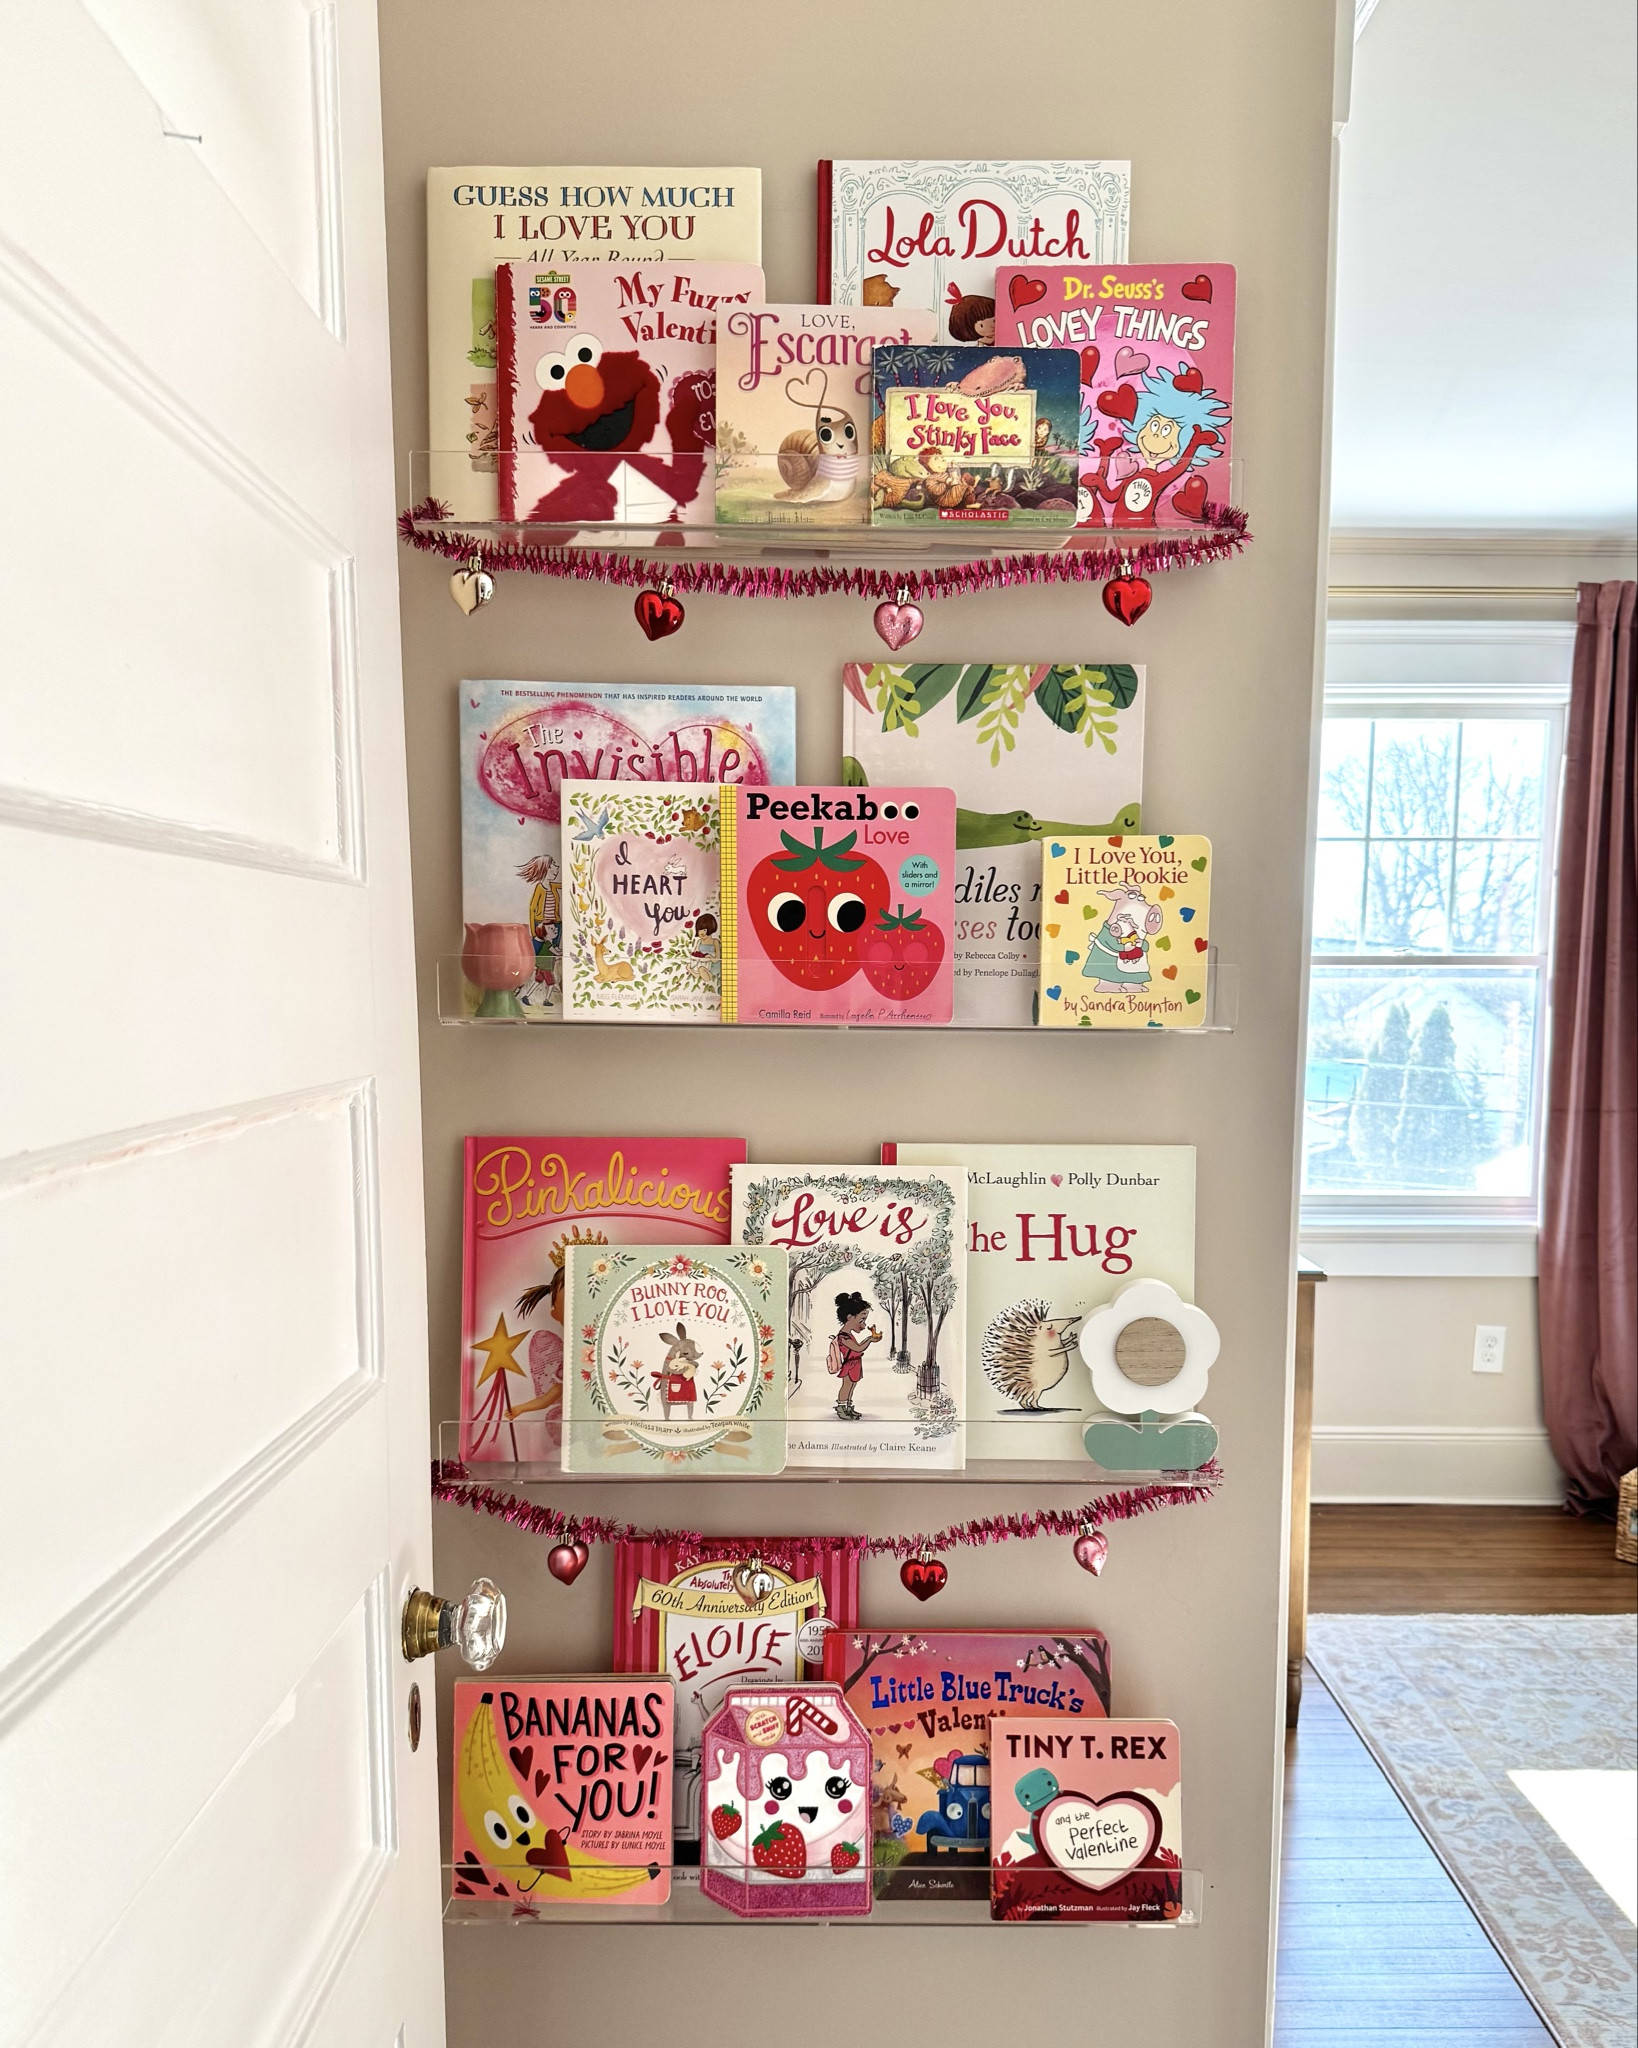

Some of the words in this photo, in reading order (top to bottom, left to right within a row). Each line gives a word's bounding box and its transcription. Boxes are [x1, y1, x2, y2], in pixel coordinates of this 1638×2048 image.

[453, 185, 549, 207] GUESS
[560, 186, 633, 207] HOW
[641, 186, 735, 208] MUCH
[494, 214, 506, 239] I
[518, 215, 613, 241] LOVE
[620, 215, 697, 241] YOU
[867, 206, 956, 267] Lola
[958, 199, 1091, 260] Dutch
[613, 271, 666, 310] My
[1063, 276, 1095, 301] Dr.
[1098, 275, 1165, 300] Seuss's
[801, 314, 856, 331] LOVE,
[1016, 305, 1104, 349] LOVEY
[1112, 305, 1210, 351] THINGS
[904, 393, 921, 421] I
[924, 394, 970, 422] Love
[974, 398, 1019, 425] You,
[906, 424, 978, 456] Stinky
[980, 427, 1022, 455] Face
[1132, 481, 1151, 498] THING
[1132, 492, 1141, 505] 2
[947, 510, 1008, 519] SCHOLASTIC
[1078, 499, 1086, 510] 1
[514, 690, 555, 698] BESTSELLING
[556, 691, 602, 699] PHENOMENON
[523, 722, 564, 748] The
[507, 728, 744, 799] Invisible
[864, 824, 910, 845] Love
[615, 841, 632, 865] I
[1074, 847, 1081, 864] I
[1088, 848, 1136, 865] Love
[1139, 846, 1183, 866] You,
[902, 871, 922, 879] sliders
[923, 871, 938, 879] and
[911, 861, 928, 869] With
[1065, 867, 1119, 885] Little
[1123, 867, 1189, 885] Pookie
[613, 874, 688, 895] HEART
[911, 880, 935, 888] mirror!
[955, 920, 997, 940] ses
[1006, 906, 1040, 941] to
[965, 951, 996, 960] Rebecca
[997, 951, 1021, 961] Colby
[963, 968, 973, 977] by
[974, 969, 1009, 978] Penelope
[758, 1009, 791, 1019] Camilla
[792, 1009, 812, 1019] Reid
[1064, 997, 1078, 1016] by
[1080, 995, 1126, 1013] Sandra
[1126, 994, 1183, 1018] Boynton
[473, 1146, 732, 1226] Pinkalicious
[967, 1171, 1047, 1188] McLaughlin
[1068, 1172, 1101, 1189] Polly
[1106, 1173, 1161, 1186] Dunbar
[769, 1192, 878, 1250] Love
[880, 1202, 929, 1245] is
[967, 1219, 1008, 1252] he
[1015, 1213, 1138, 1275] Hug
[630, 1282, 691, 1303] BUNNY
[693, 1282, 729, 1304] ROO,
[631, 1306, 641, 1322] I
[643, 1300, 691, 1319] LOVE
[692, 1301, 731, 1323] YOU
[799, 1441, 829, 1450] Adams
[831, 1443, 868, 1451] Illustrated
[868, 1444, 879, 1453] by
[879, 1442, 906, 1452] Claire
[908, 1443, 937, 1452] Keane
[651, 1588, 684, 1610] 60th
[768, 1590, 814, 1611] Edition
[673, 1621, 792, 1682] ELOISE
[869, 1675, 935, 1709] Little
[940, 1671, 992, 1702] Blue
[994, 1671, 1085, 1714] Truck's
[500, 1691, 664, 1741] BANANAS
[749, 1715, 777, 1731] SCRATCH
[917, 1706, 1006, 1739] Valen
[1006, 1735, 1074, 1759] TINY
[1080, 1735, 1104, 1759] T.
[1111, 1736, 1167, 1759] REX
[553, 1743, 629, 1783] FOR
[554, 1771, 659, 1833] YOU!
[1055, 1814, 1072, 1826] and
[1075, 1811, 1091, 1822] the
[580, 1840, 610, 1849] PICTURES
[611, 1841, 620, 1849] BY
[621, 1841, 643, 1849] EUNICE
[644, 1841, 667, 1850] MOYLE
[581, 1830, 602, 1838] STORY
[603, 1830, 613, 1838] BY
[614, 1830, 640, 1839] SABRINA
[641, 1830, 663, 1840] MOYLE
[1024, 1904, 1058, 1912] Jonathan
[1128, 1904, 1141, 1913] Jay
[1141, 1904, 1161, 1912] Fleck
